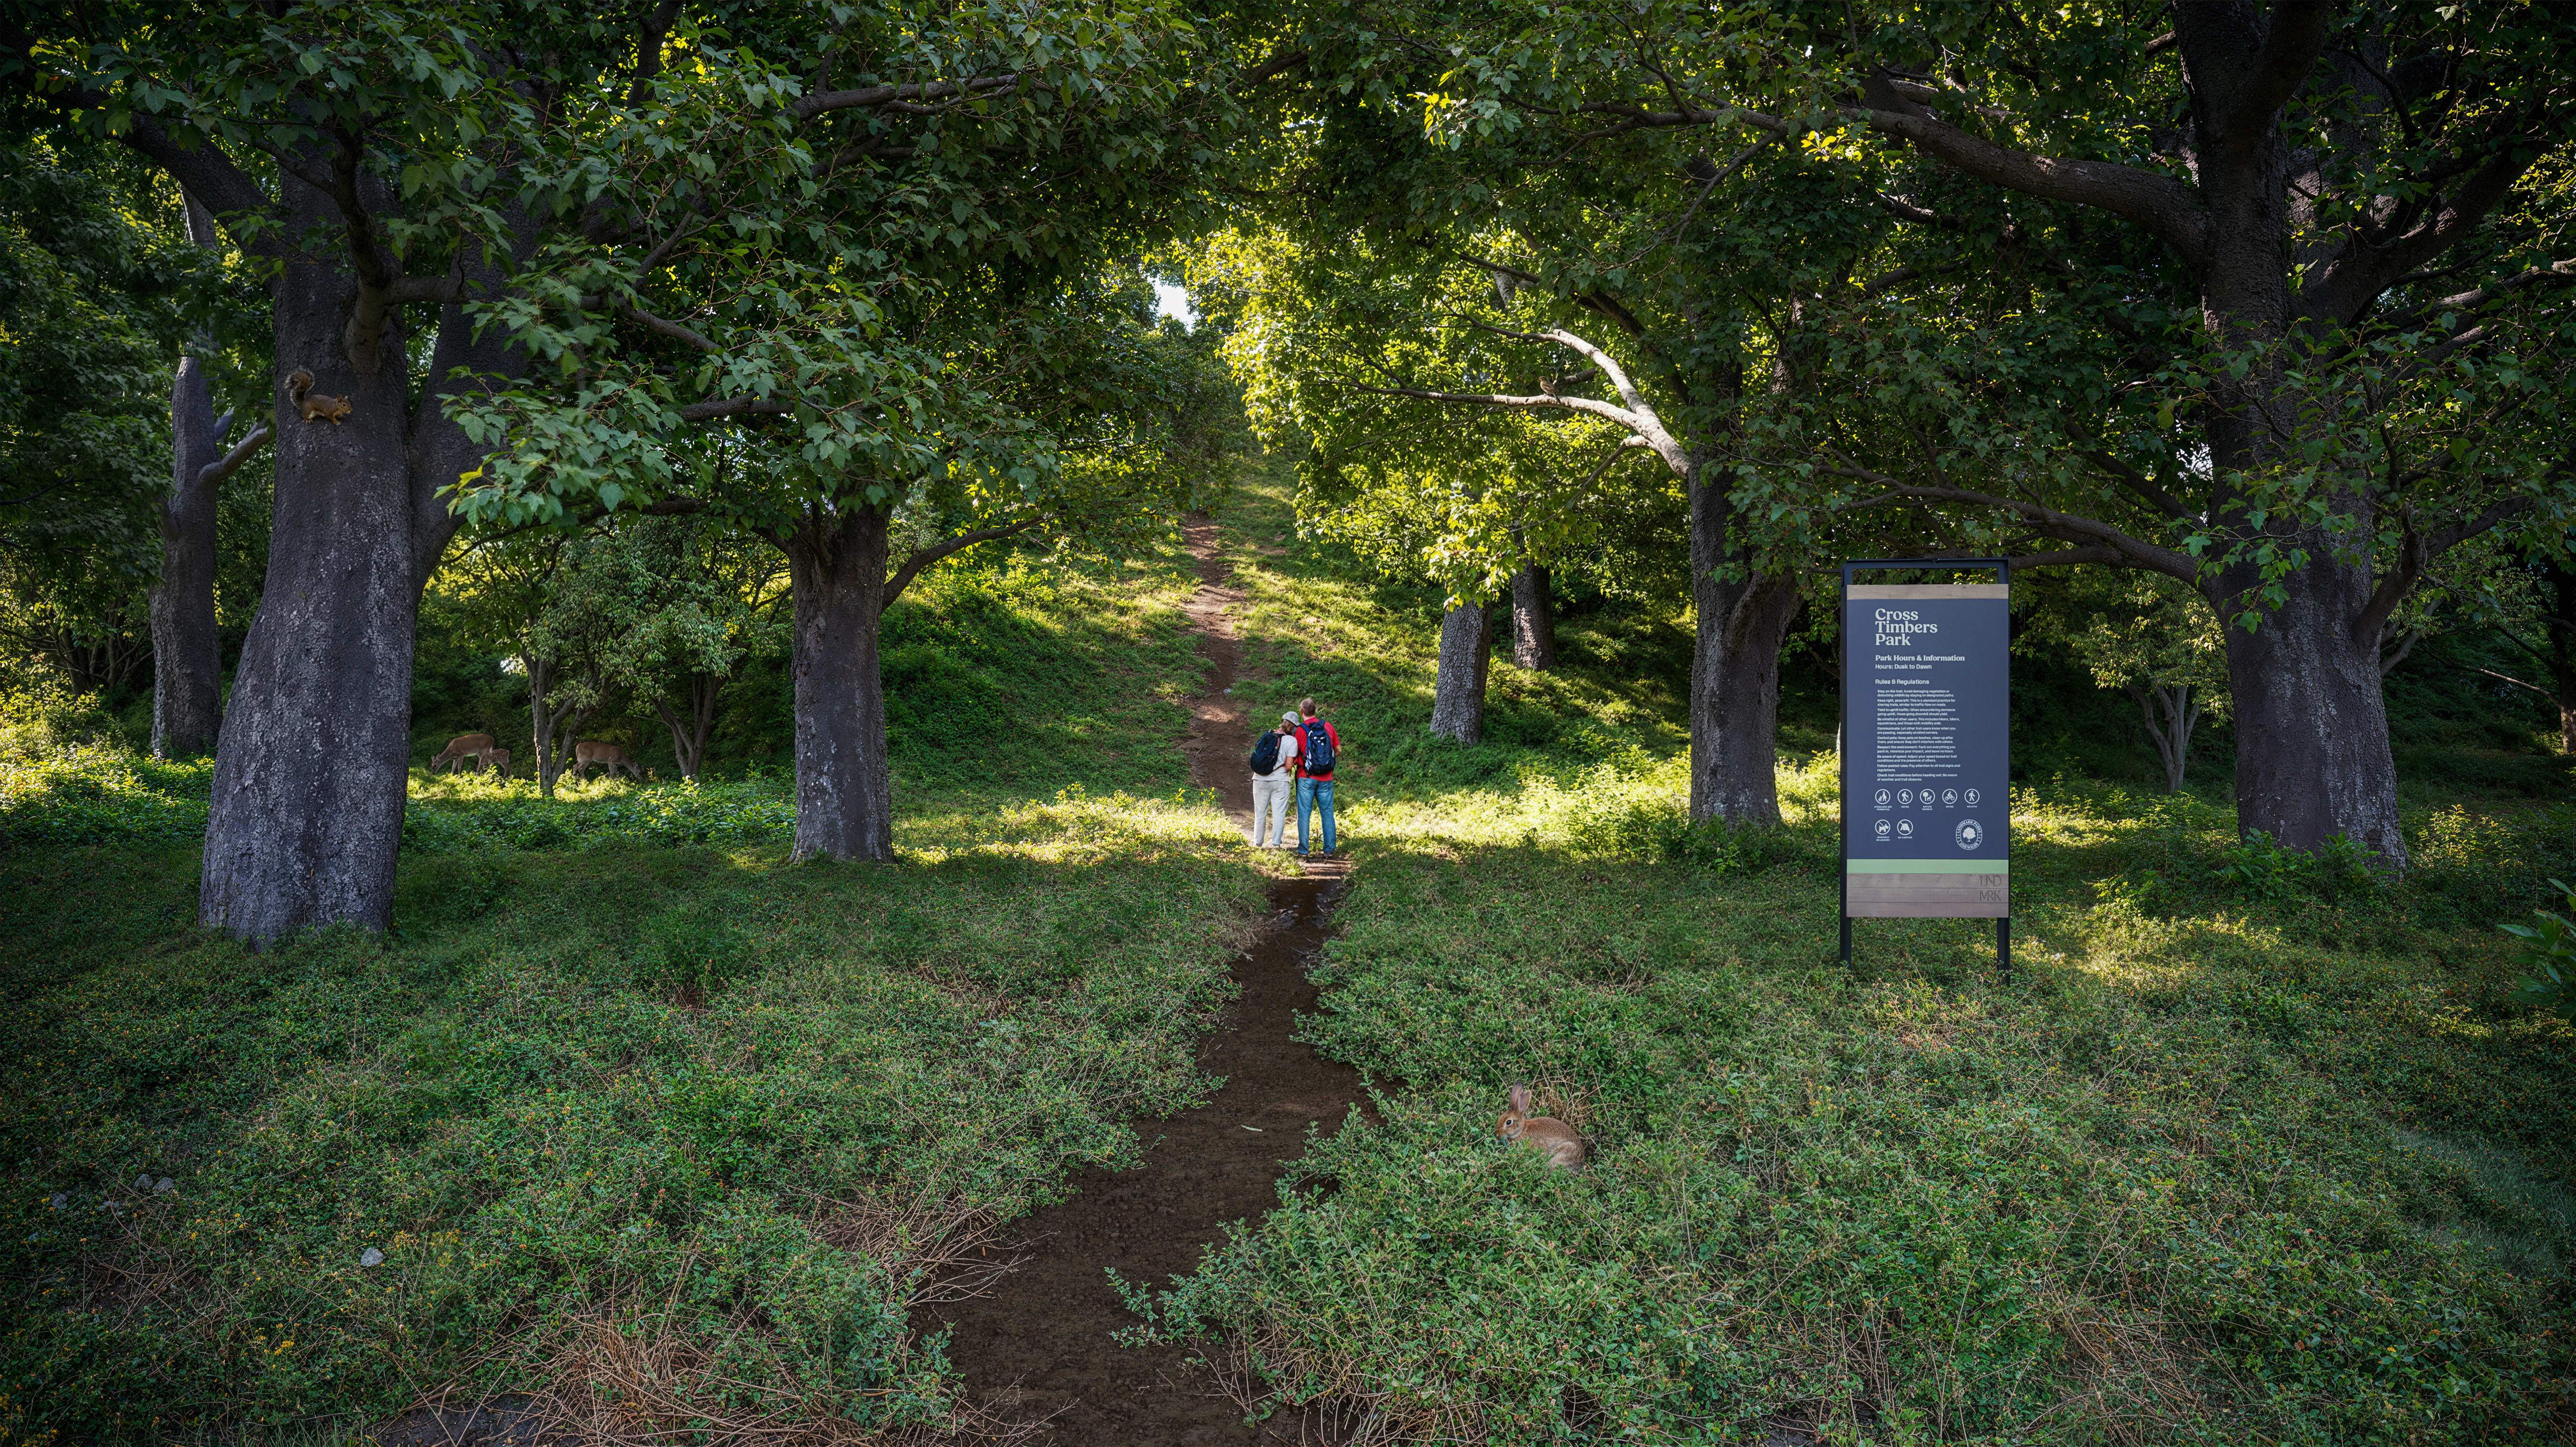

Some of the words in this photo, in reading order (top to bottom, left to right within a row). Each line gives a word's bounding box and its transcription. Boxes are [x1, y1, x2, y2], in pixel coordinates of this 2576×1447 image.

[1875, 608, 1918, 620] Cross
[1875, 620, 1938, 633] Timbers
[1875, 633, 1911, 645] Park
[1957, 820, 1974, 833] LANDMARK
[1979, 890, 2002, 901] MRK
